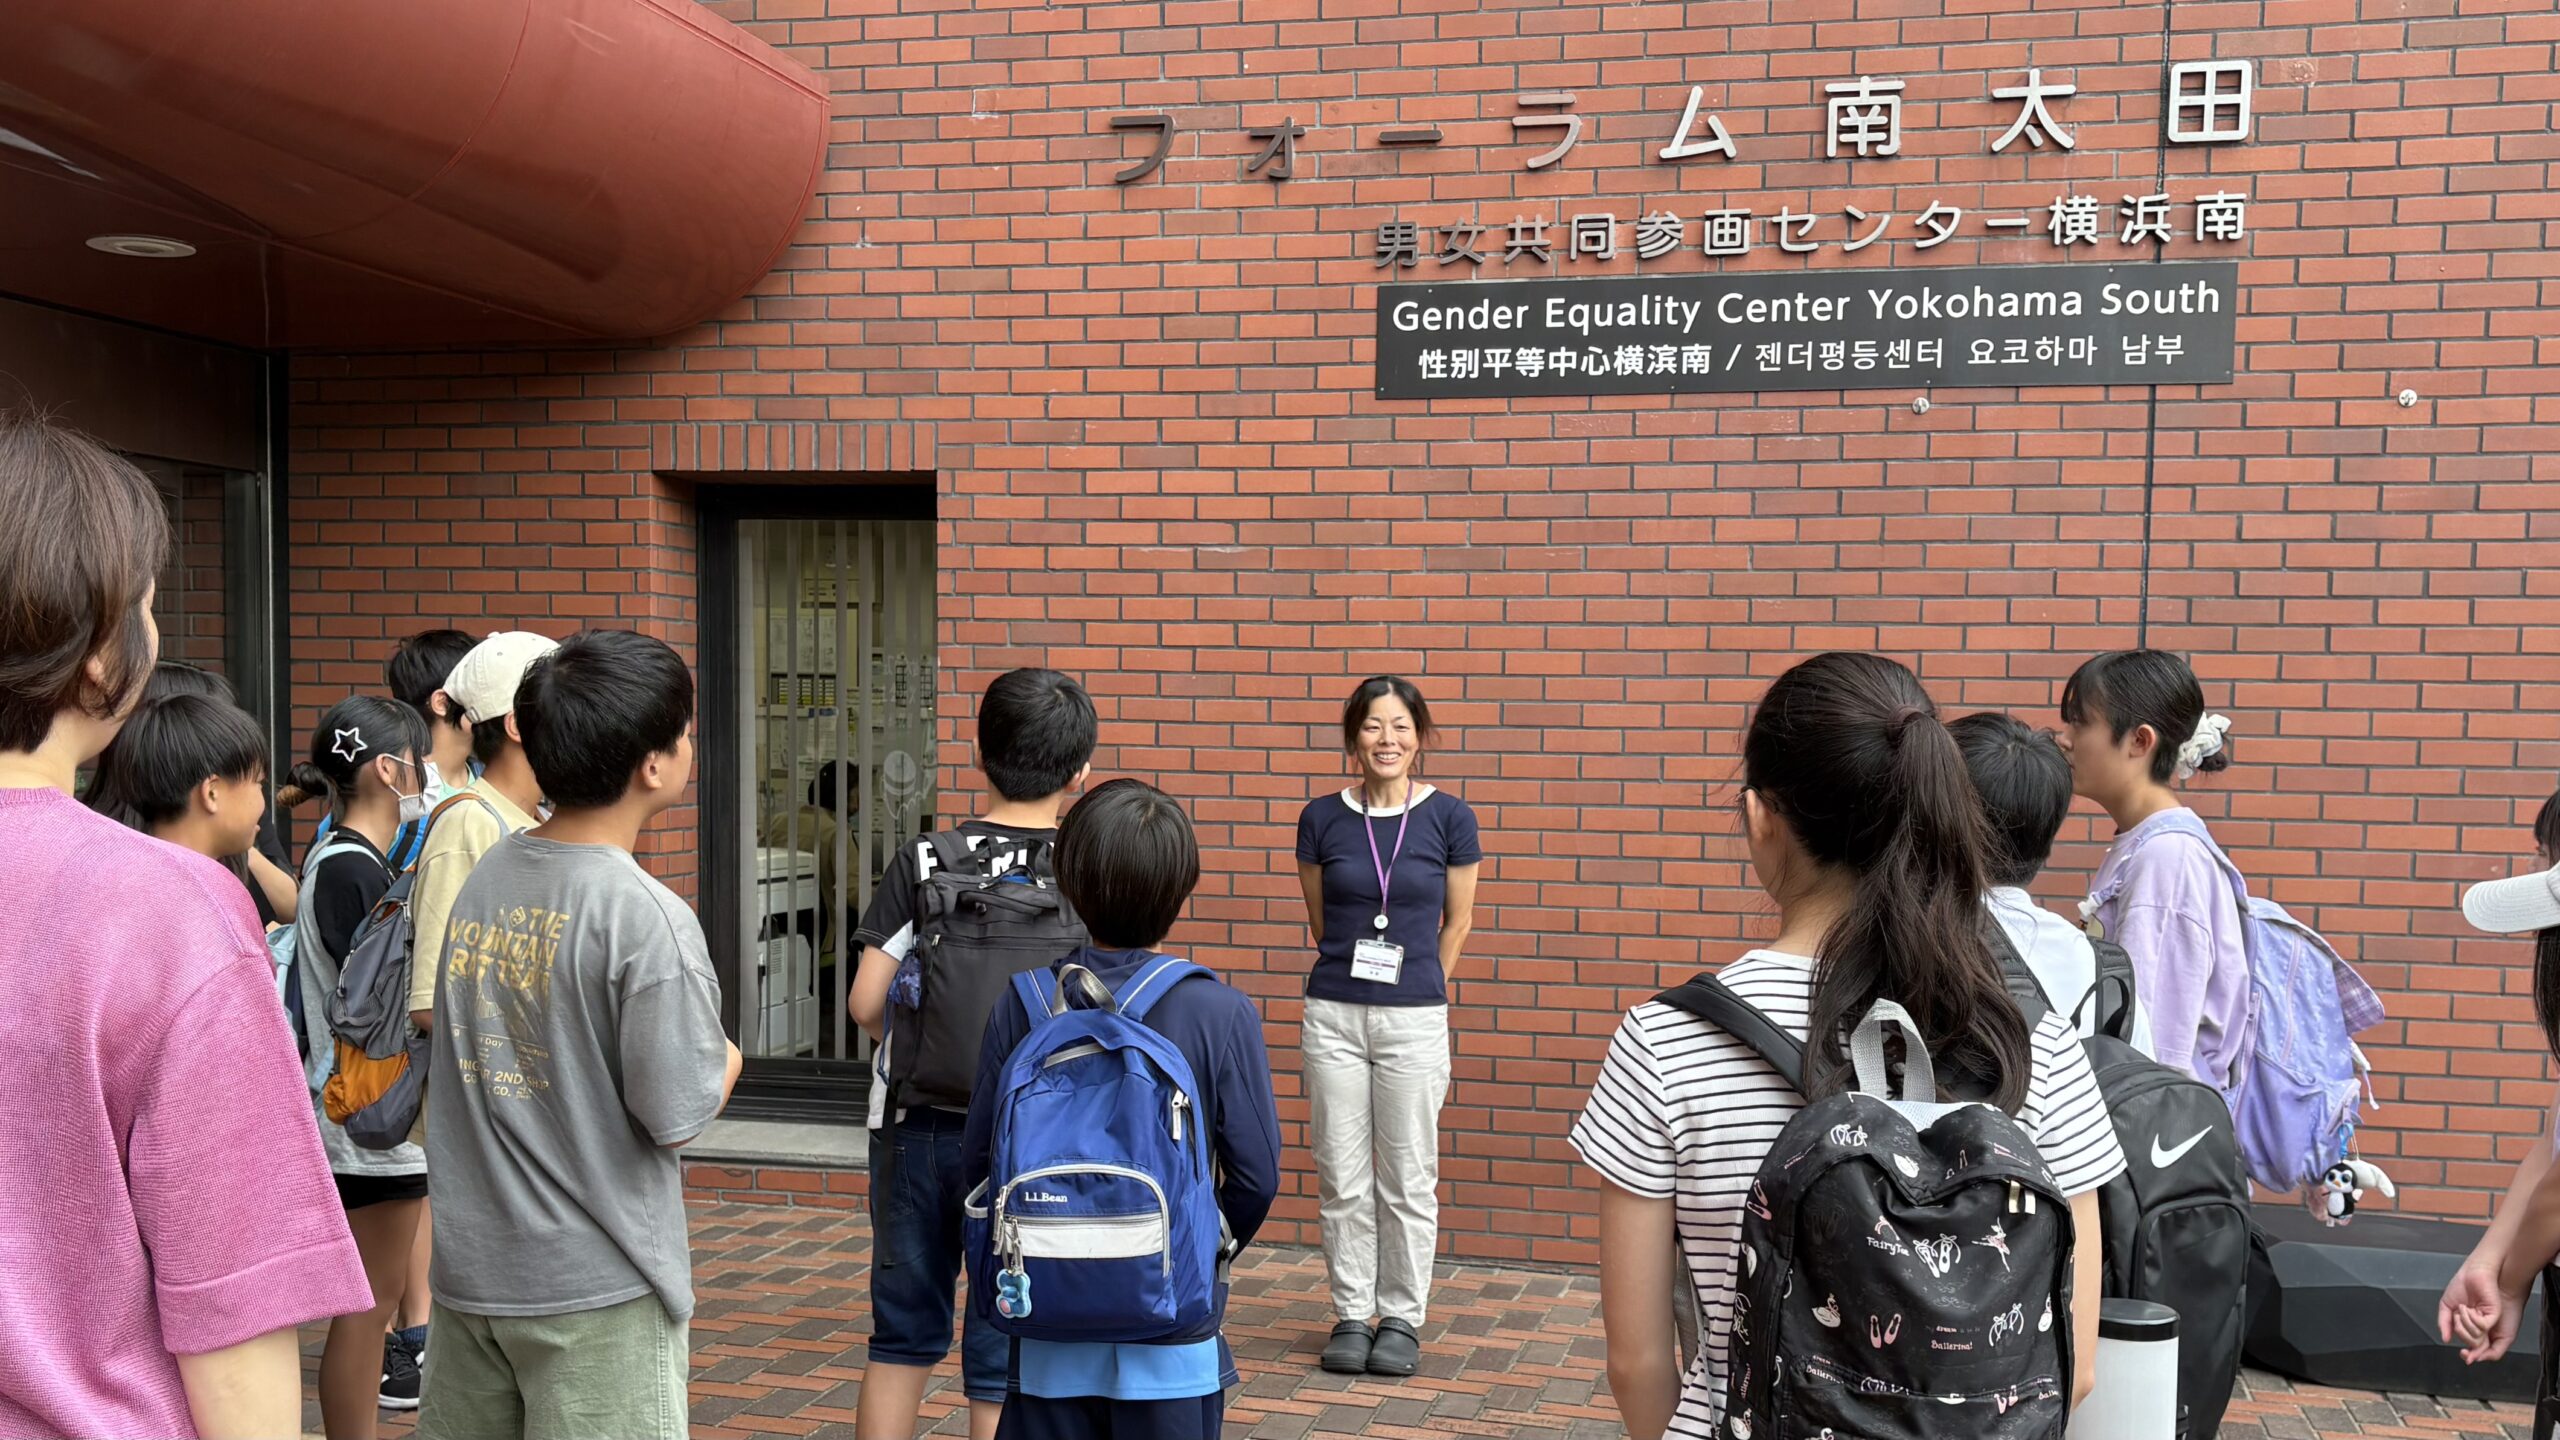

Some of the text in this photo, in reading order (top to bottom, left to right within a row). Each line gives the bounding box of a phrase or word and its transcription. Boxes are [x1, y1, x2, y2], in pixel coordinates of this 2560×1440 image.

[1376, 190, 2248, 269] 男女共同参画センター横浜南
[1392, 279, 2221, 337] Gender Equality Center Yokohama South
[1418, 342, 1713, 380] 性别平等中心横滨南
[1754, 337, 1943, 372] 젠더평등센터
[1967, 334, 2099, 367] 요코하마
[2121, 333, 2186, 366] 남부
